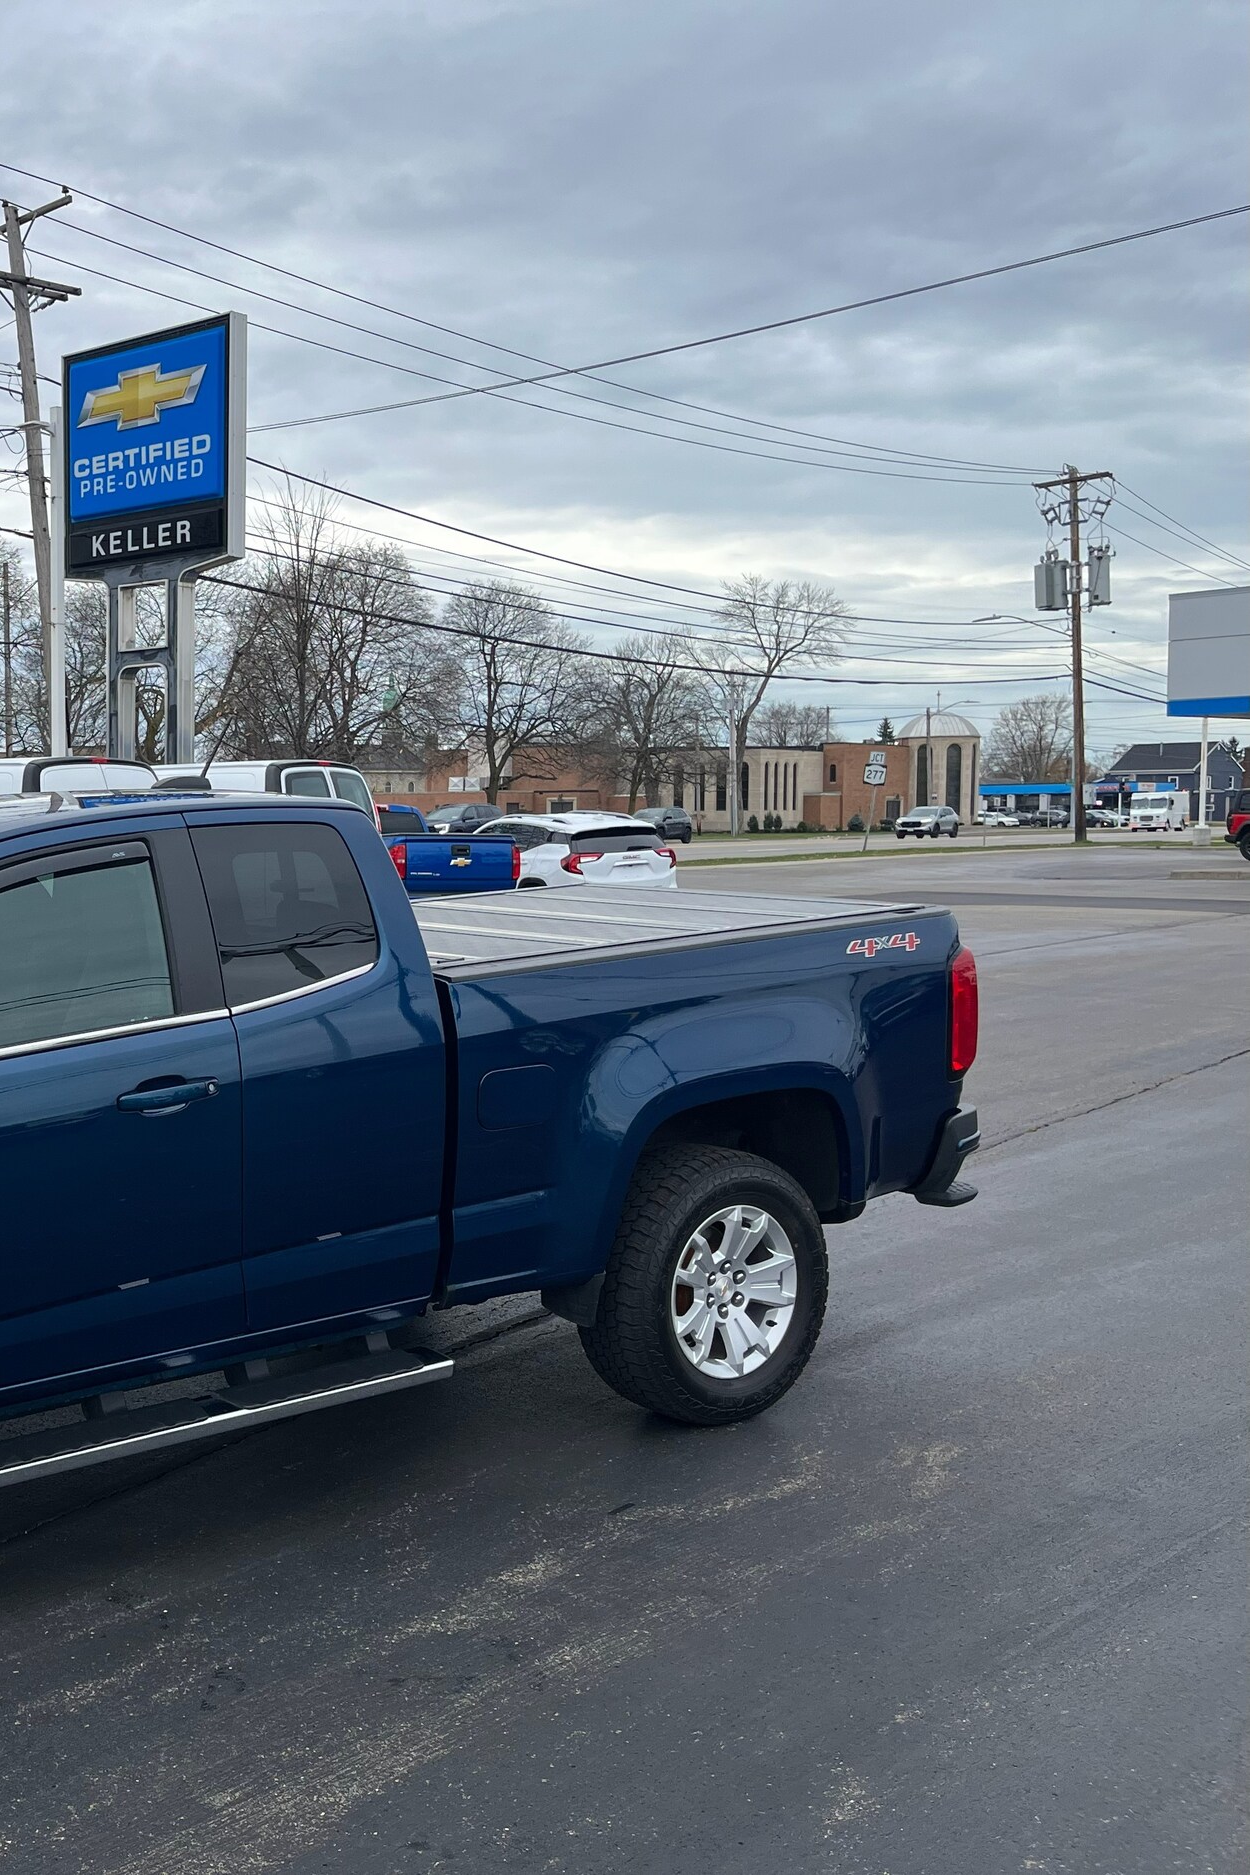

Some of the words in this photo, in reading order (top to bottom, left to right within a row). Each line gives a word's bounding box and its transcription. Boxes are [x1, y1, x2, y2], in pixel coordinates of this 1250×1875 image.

[74, 434, 211, 478] CERTIFIED
[80, 458, 204, 498] PRE-OWNED
[91, 520, 192, 557] KELLER
[866, 770, 884, 780] 277
[871, 754, 883, 762] JCT
